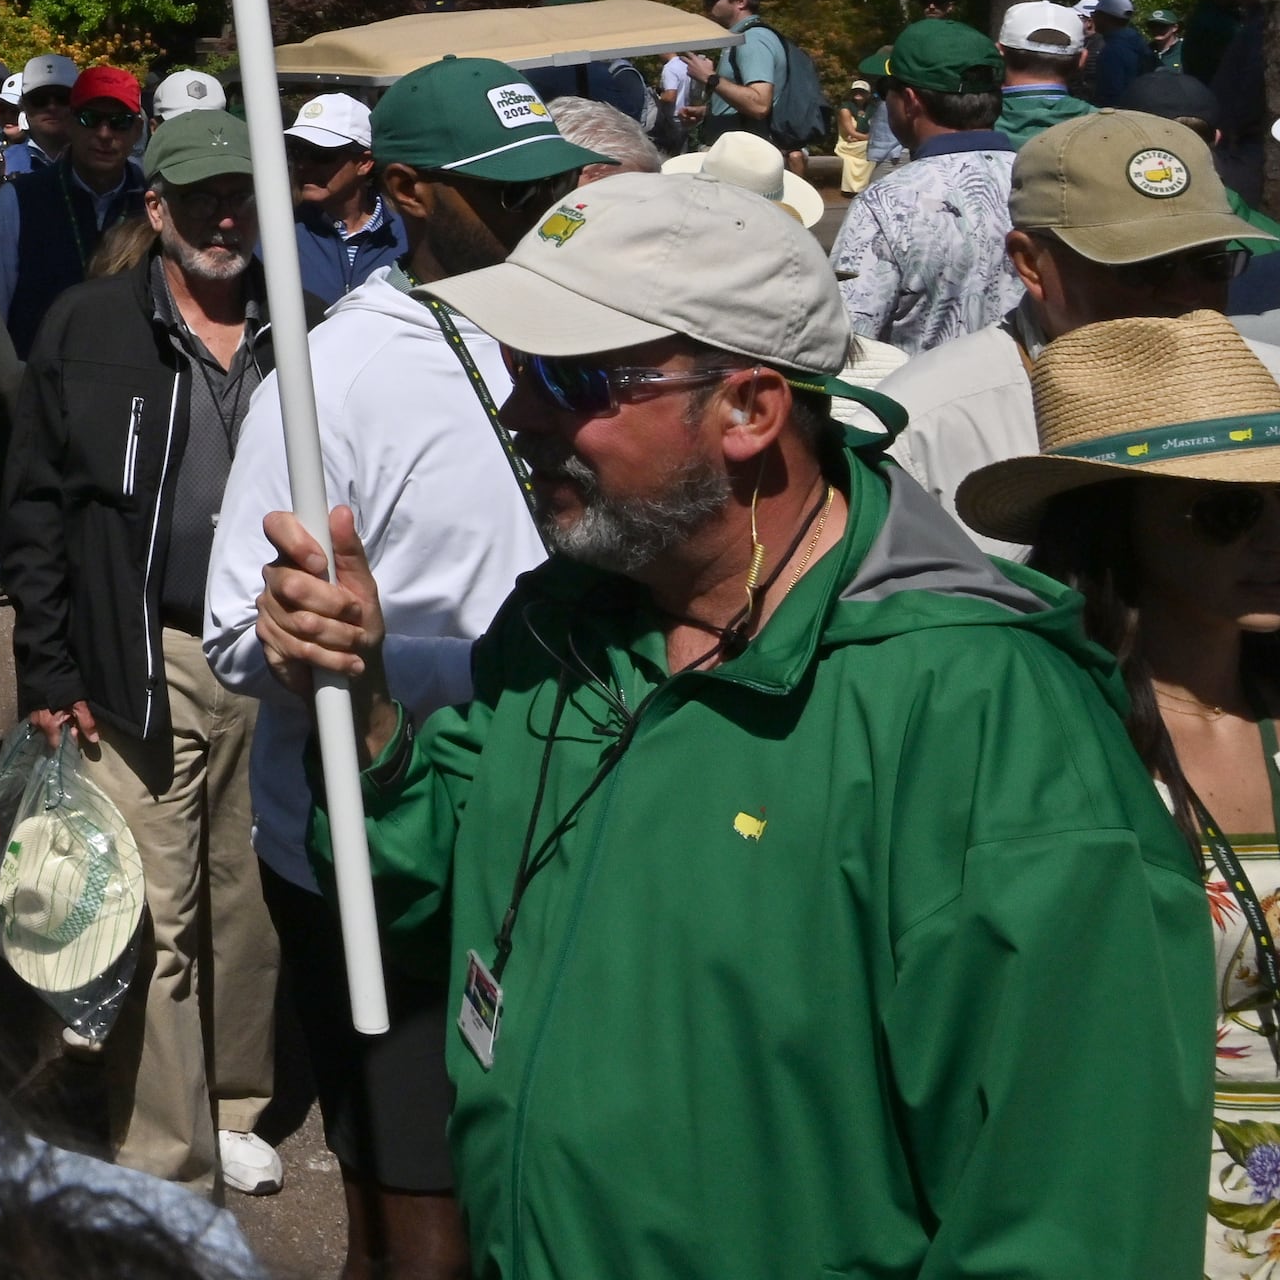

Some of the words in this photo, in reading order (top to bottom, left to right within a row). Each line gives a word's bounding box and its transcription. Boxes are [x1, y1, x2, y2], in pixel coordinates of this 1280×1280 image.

[500, 90, 516, 99] the
[503, 106, 531, 119] 2025
[1135, 151, 1174, 166] MASTERS
[1140, 177, 1185, 193] TOURNAMENT
